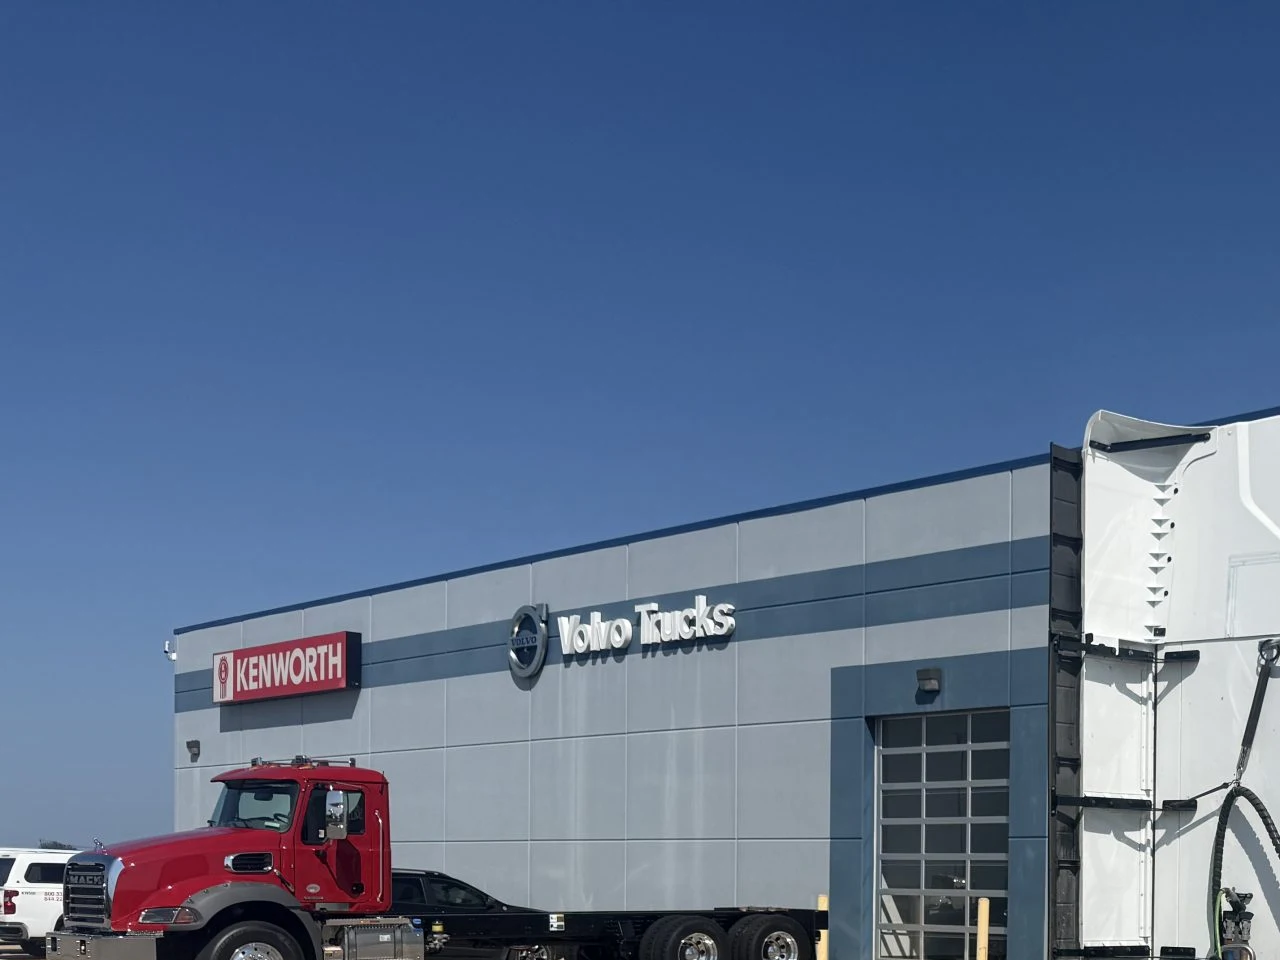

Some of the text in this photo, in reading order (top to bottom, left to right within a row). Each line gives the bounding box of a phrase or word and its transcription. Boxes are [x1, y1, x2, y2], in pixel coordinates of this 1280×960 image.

[557, 595, 735, 655] Volvo Trucks
[511, 636, 537, 647] VOLVO
[236, 642, 342, 692] KENWORTH
[70, 875, 101, 884] MACK
